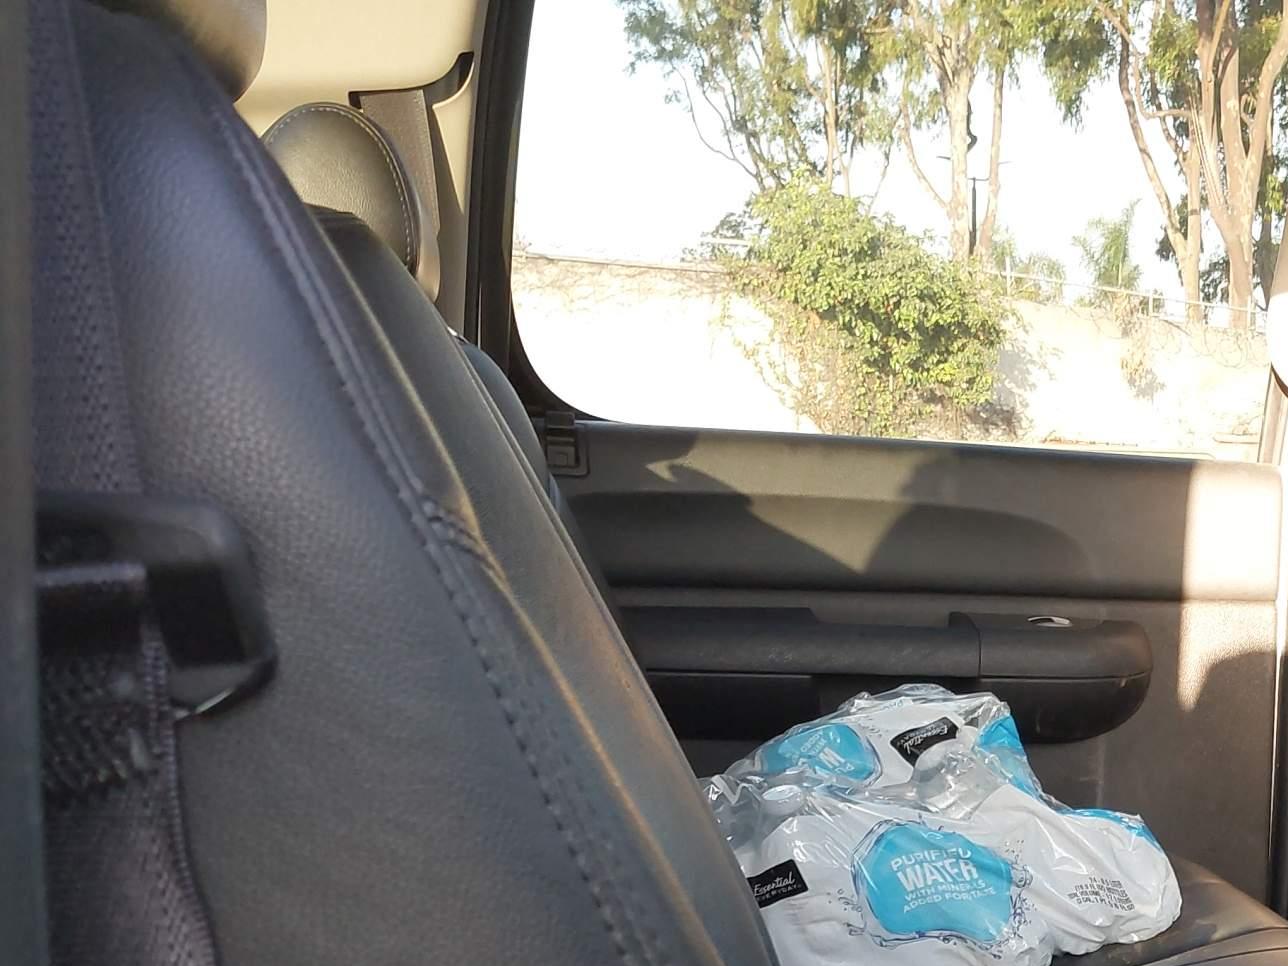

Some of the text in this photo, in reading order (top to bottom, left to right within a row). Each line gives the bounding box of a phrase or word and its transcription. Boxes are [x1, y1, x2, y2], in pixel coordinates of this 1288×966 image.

[754, 871, 796, 897] Essential
[896, 858, 979, 892] WATER
[903, 894, 942, 914] ADDED
[905, 886, 936, 902] WITH
